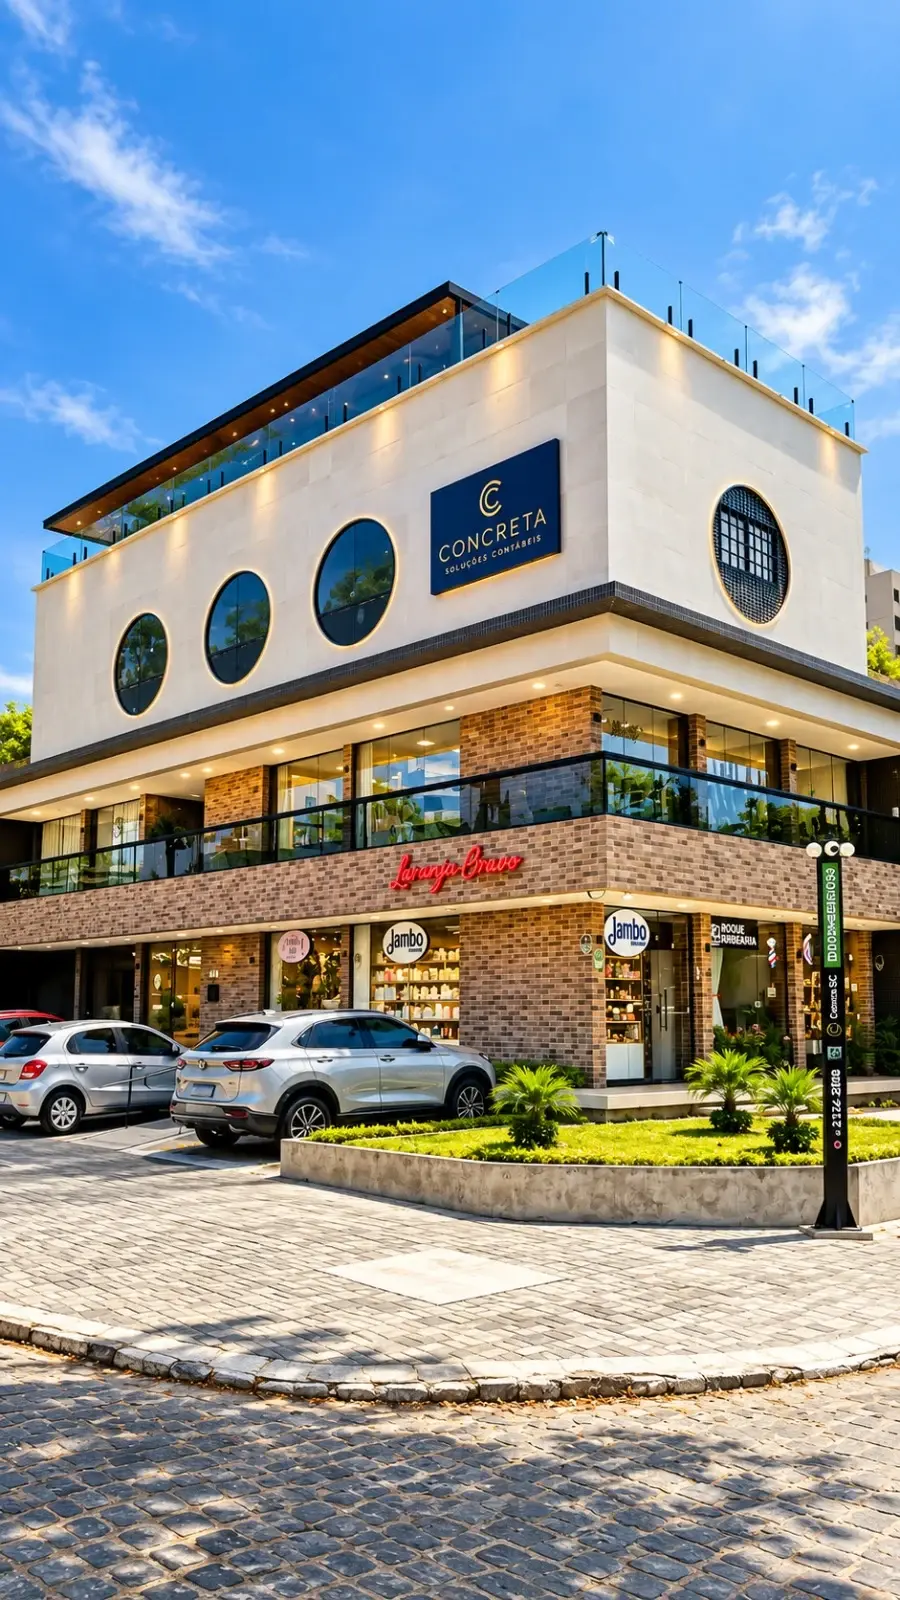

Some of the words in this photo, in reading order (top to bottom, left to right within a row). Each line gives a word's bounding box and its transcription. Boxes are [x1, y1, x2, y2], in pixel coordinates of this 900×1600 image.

[438, 508, 547, 563] CONCRETA
[444, 553, 488, 575] SOLUÇÕES
[491, 534, 542, 558] CONTÁBEIS
[389, 853, 461, 894] Laranja
[386, 927, 424, 955] Jambo
[607, 915, 647, 946] Jambo
